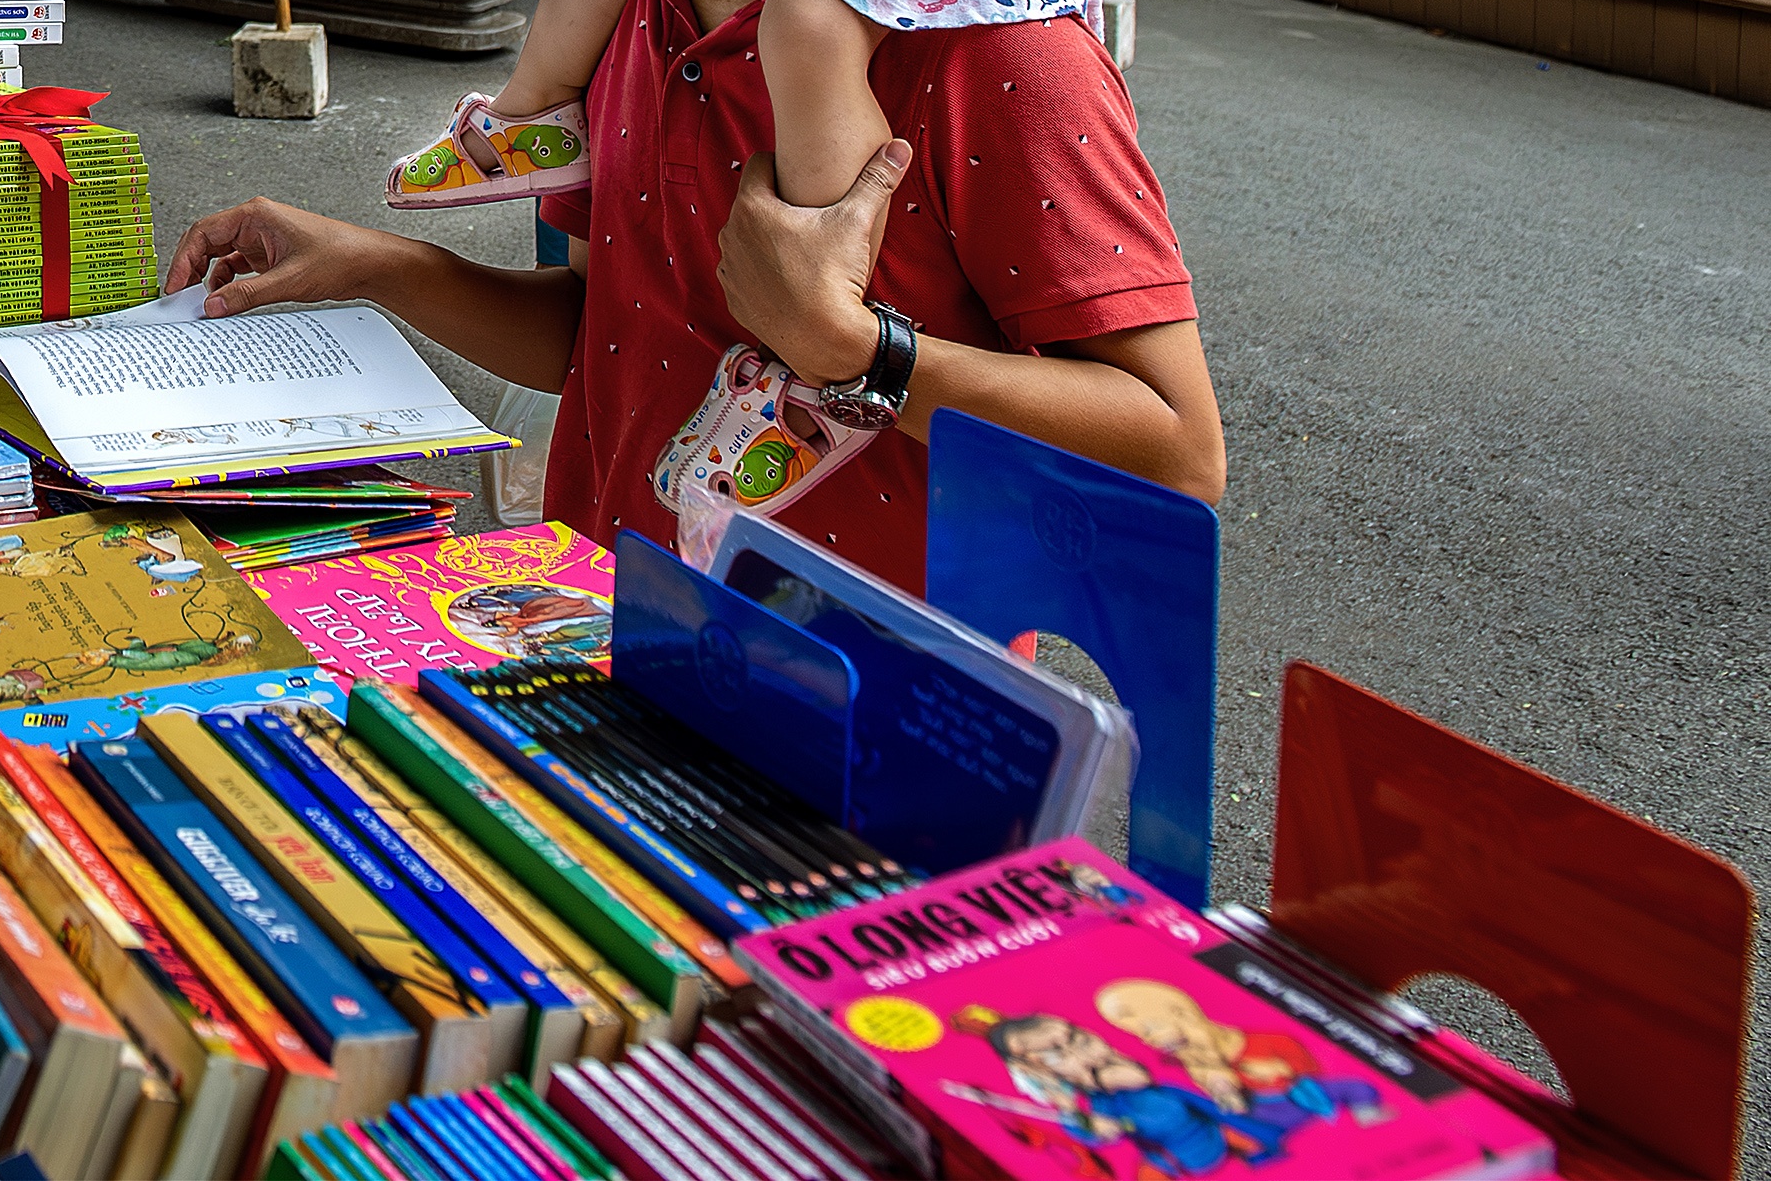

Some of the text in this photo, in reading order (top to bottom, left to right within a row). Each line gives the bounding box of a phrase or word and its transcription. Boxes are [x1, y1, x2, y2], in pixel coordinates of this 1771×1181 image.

[294, 602, 410, 679] THOẠI
[776, 936, 835, 981] Ô
[830, 899, 970, 973] LONG
